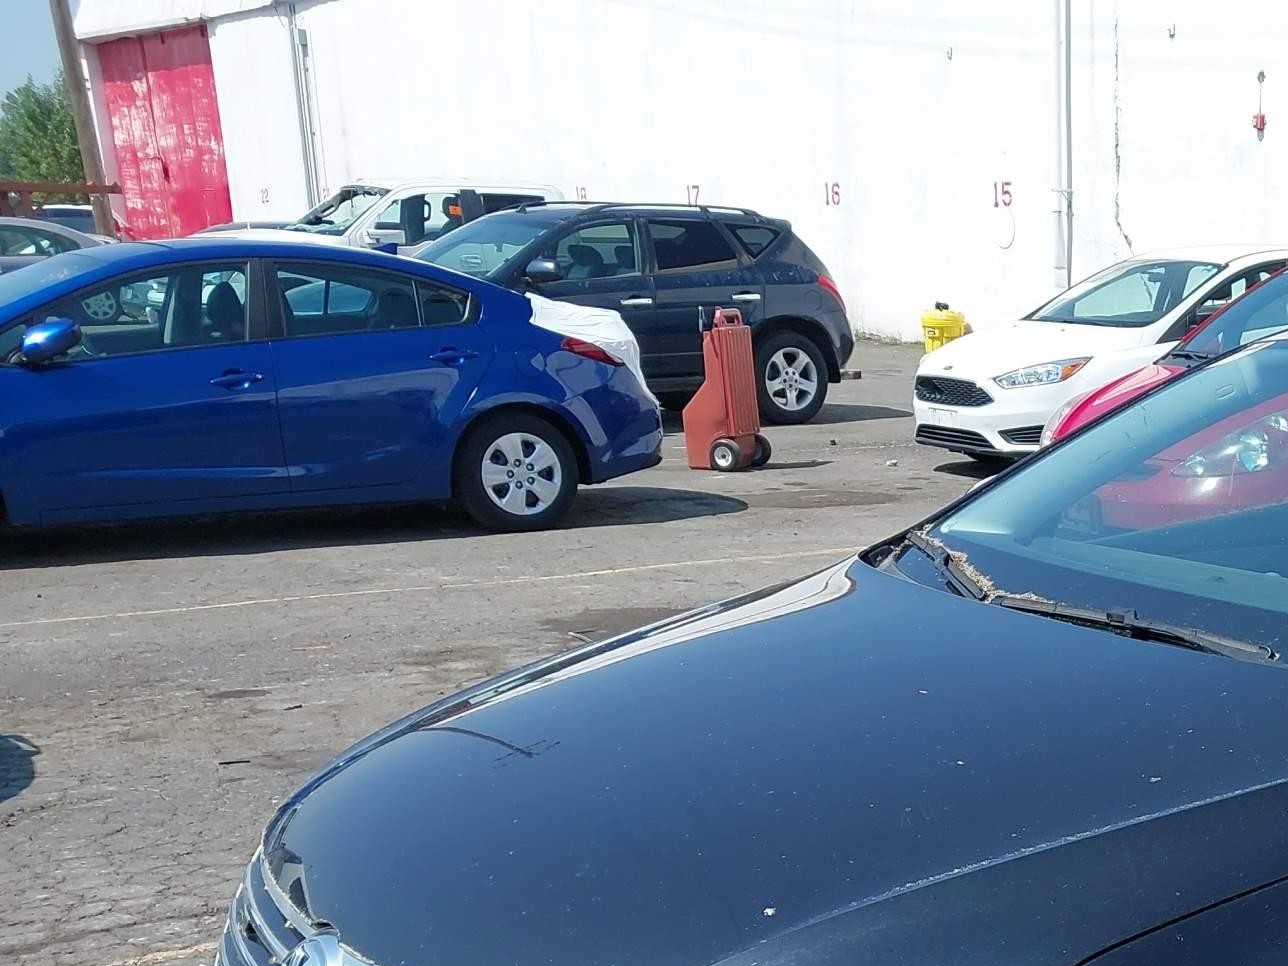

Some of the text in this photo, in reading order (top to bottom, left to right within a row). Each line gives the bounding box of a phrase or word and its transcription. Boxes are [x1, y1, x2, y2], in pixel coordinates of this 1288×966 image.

[686, 184, 700, 208] 17
[825, 182, 841, 206] 16
[993, 181, 1013, 208] 15
